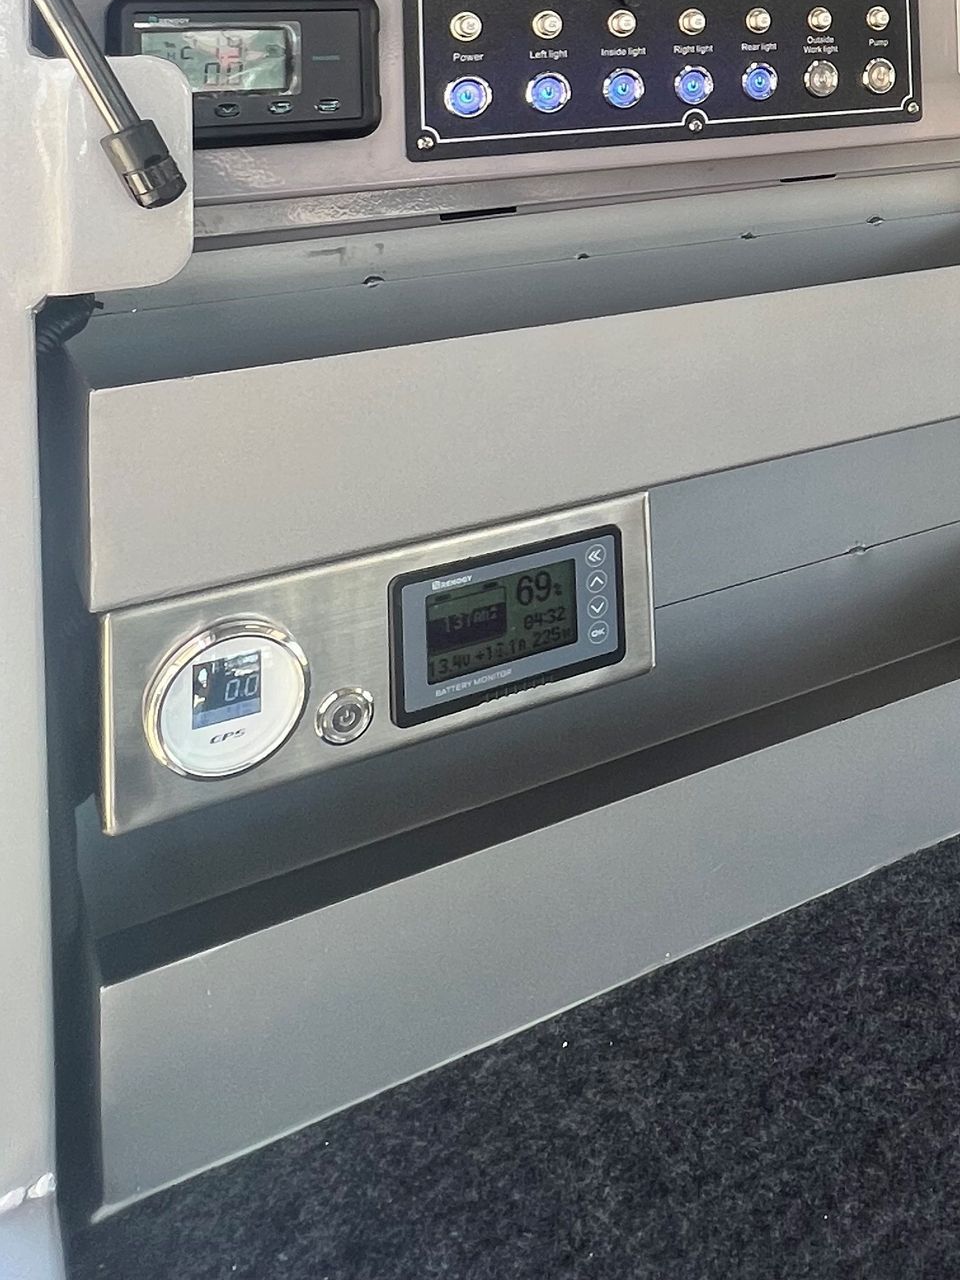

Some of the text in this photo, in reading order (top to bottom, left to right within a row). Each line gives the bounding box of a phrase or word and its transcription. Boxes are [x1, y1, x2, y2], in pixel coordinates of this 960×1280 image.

[806, 35, 834, 45] Outside
[868, 38, 889, 49] Pump
[600, 46, 646, 57] Inside light
[673, 44, 714, 55] Right light
[741, 42, 777, 52] Rear light
[803, 45, 839, 55] Work light
[453, 52, 484, 63] Power
[529, 49, 568, 60] Left light
[591, 626, 605, 638] OK
[434, 668, 513, 698] BATTERY MONITOR
